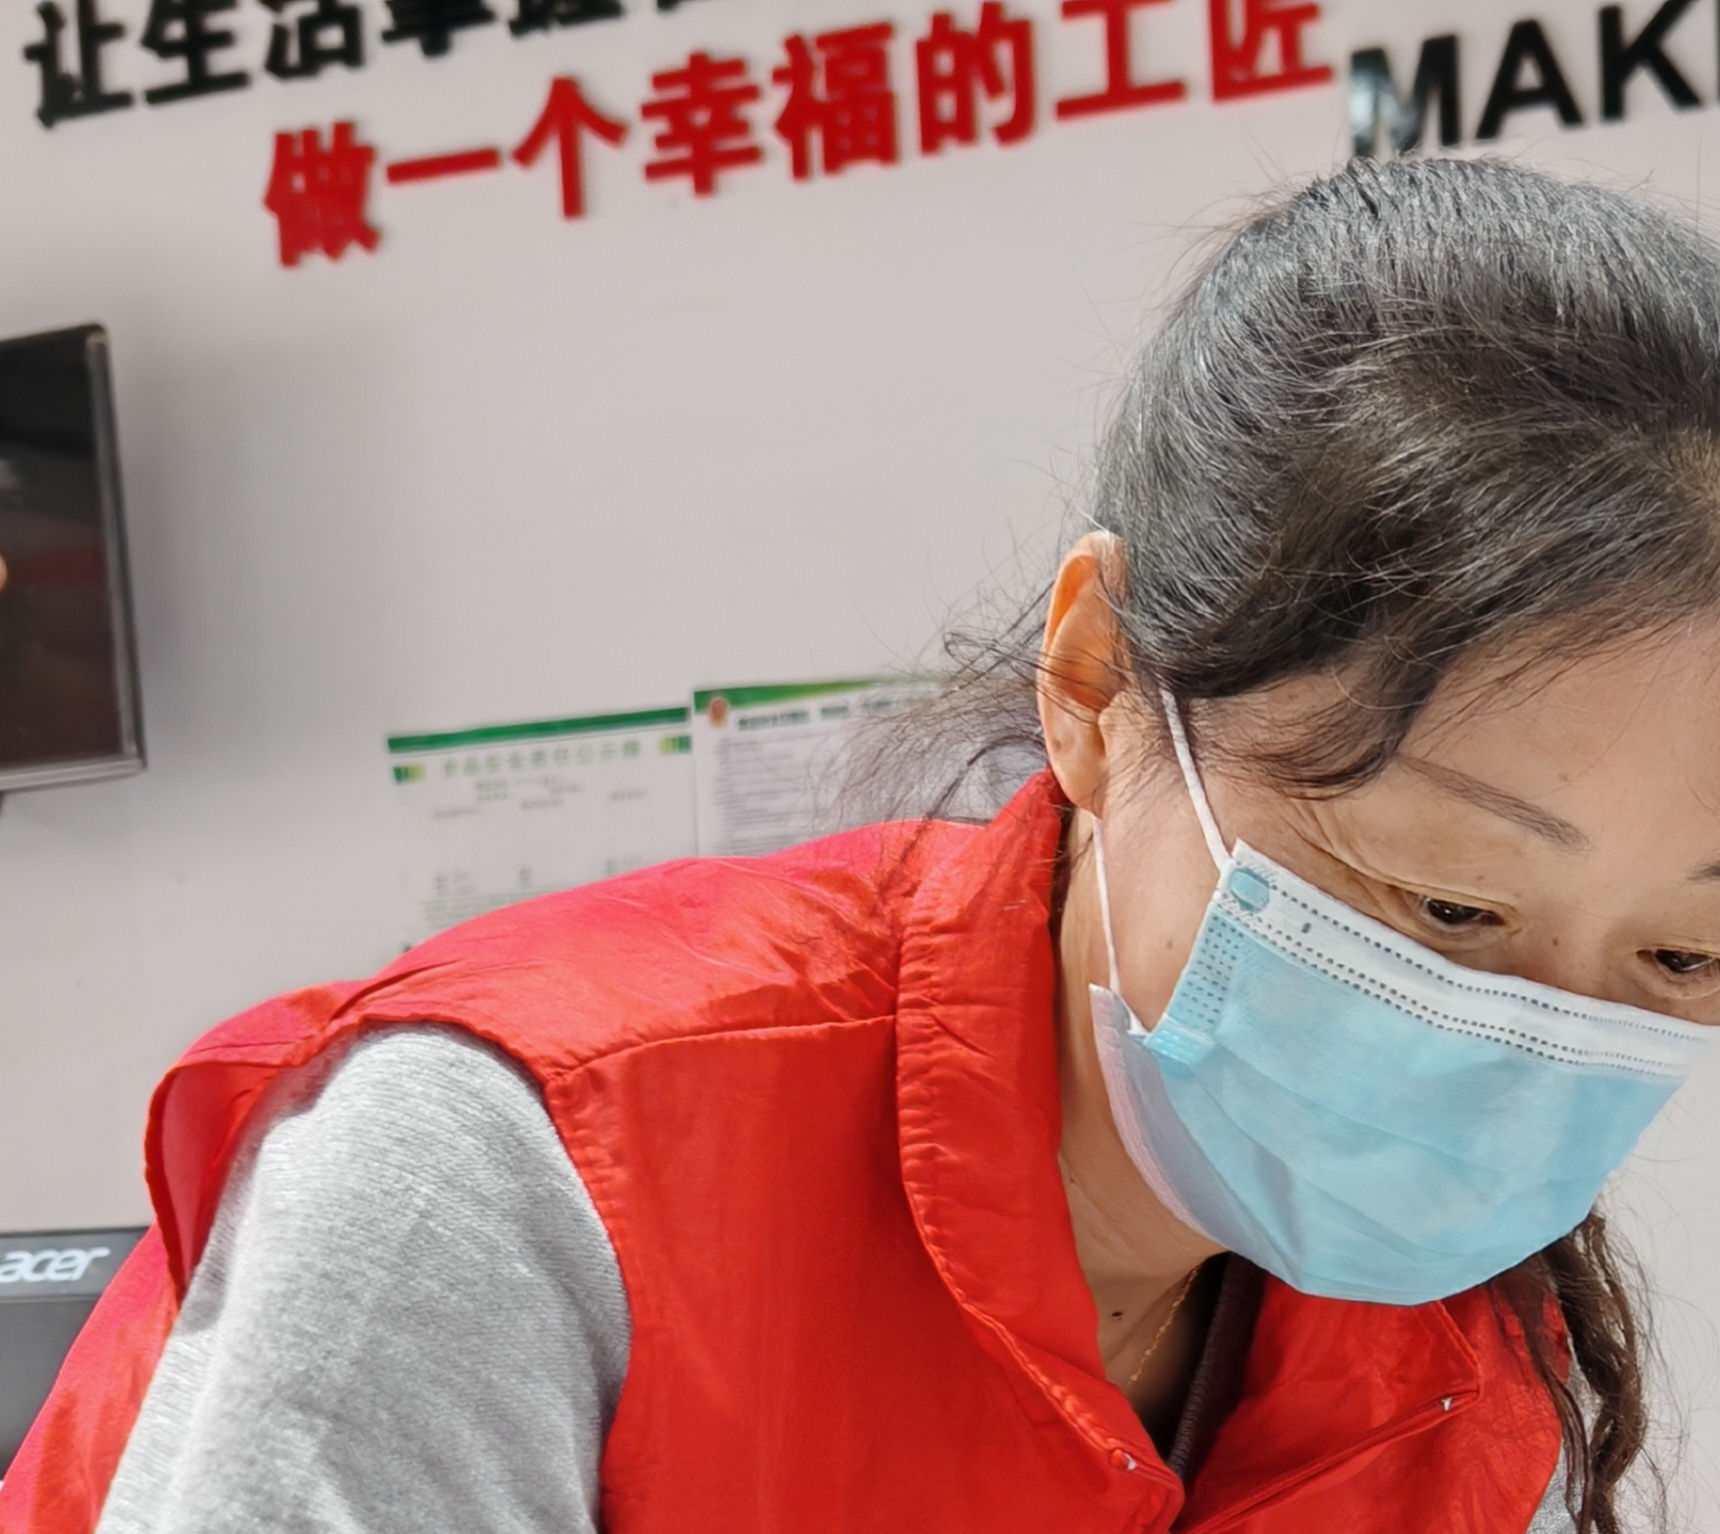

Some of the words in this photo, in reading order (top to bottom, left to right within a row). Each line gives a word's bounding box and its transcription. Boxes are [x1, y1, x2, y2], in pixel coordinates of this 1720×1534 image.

[263, 0, 1335, 268] 做一个幸福的工匠
[0, 1246, 110, 1283] acer
